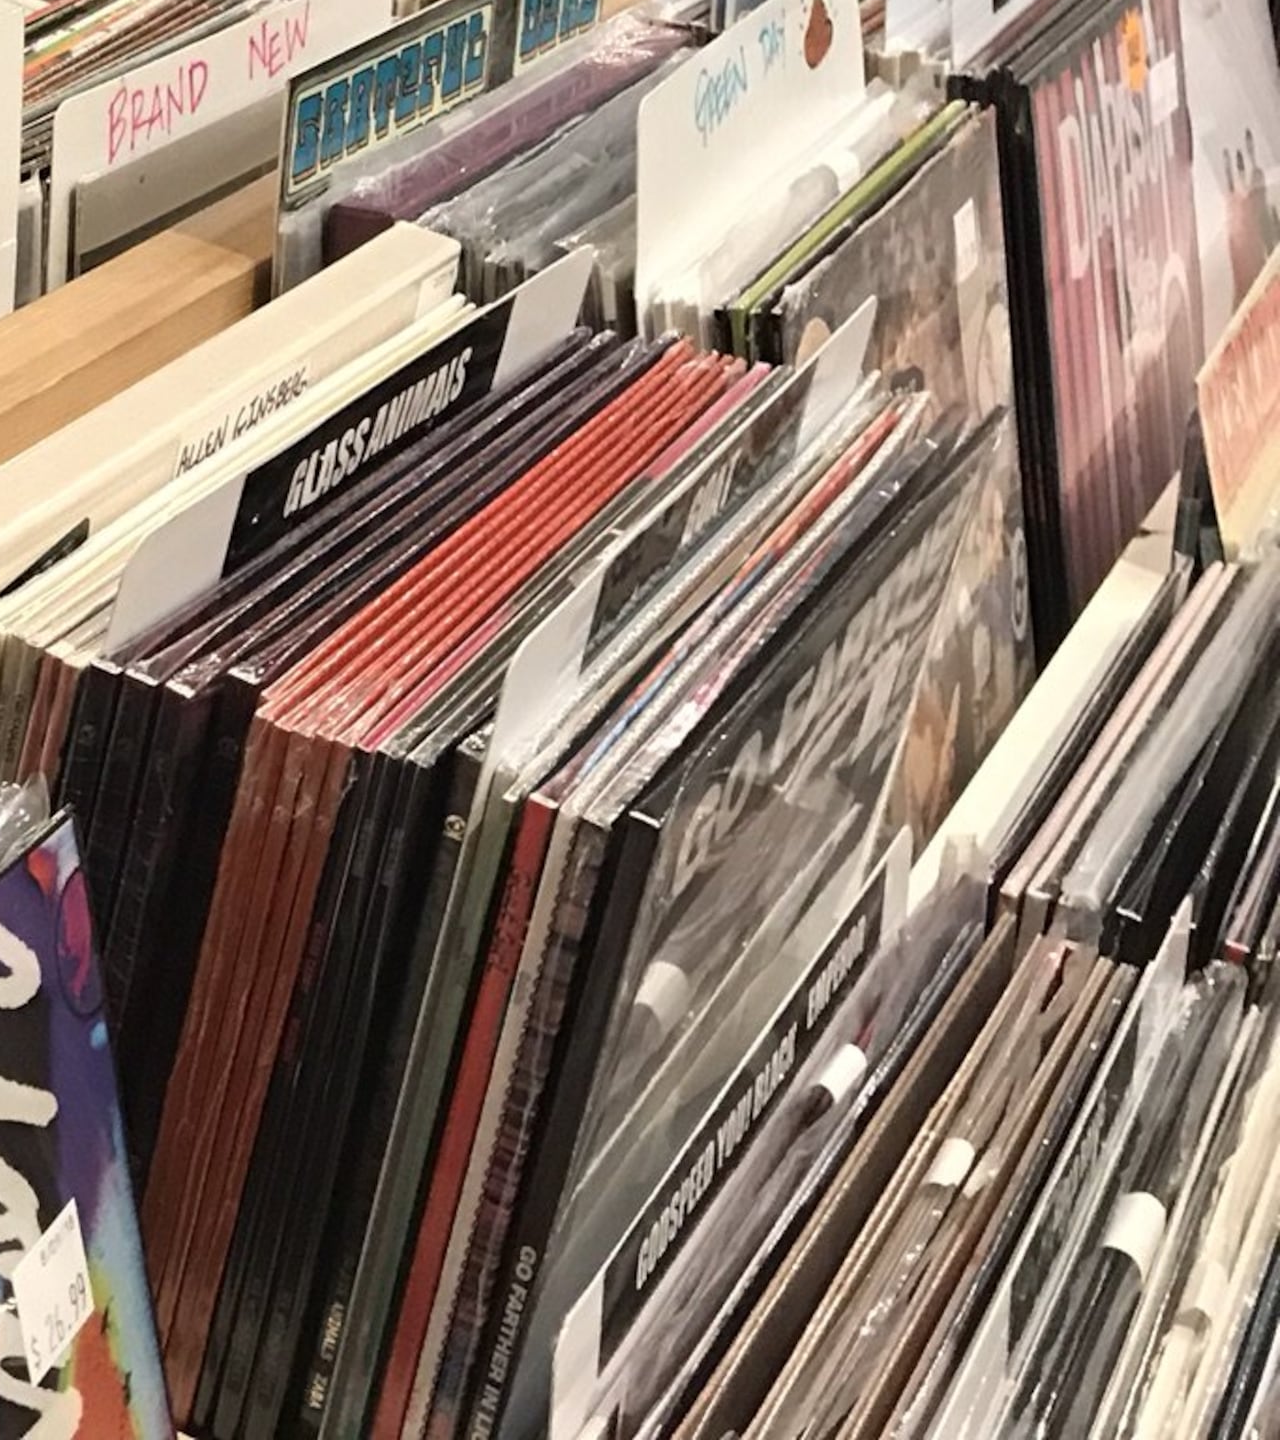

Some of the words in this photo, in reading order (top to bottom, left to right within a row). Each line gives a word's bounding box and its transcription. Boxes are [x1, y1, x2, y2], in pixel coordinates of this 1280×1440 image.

[107, 58, 209, 164] BRAND
[247, 0, 311, 80] NEW
[291, 7, 488, 180] GRATEFUL
[694, 44, 748, 144] GREEN
[175, 413, 230, 479] ALLEN
[231, 366, 309, 440] GINSBERG
[282, 416, 373, 520] GLASS
[361, 345, 473, 463] ANIMALS
[634, 1138, 716, 1292] GODSPEED
[751, 1020, 799, 1121] BLACK
[805, 913, 868, 1032] EMPEROR
[514, 1244, 537, 1282] GO
[488, 1282, 529, 1385] FARTHER
[481, 1383, 502, 1412] IN
